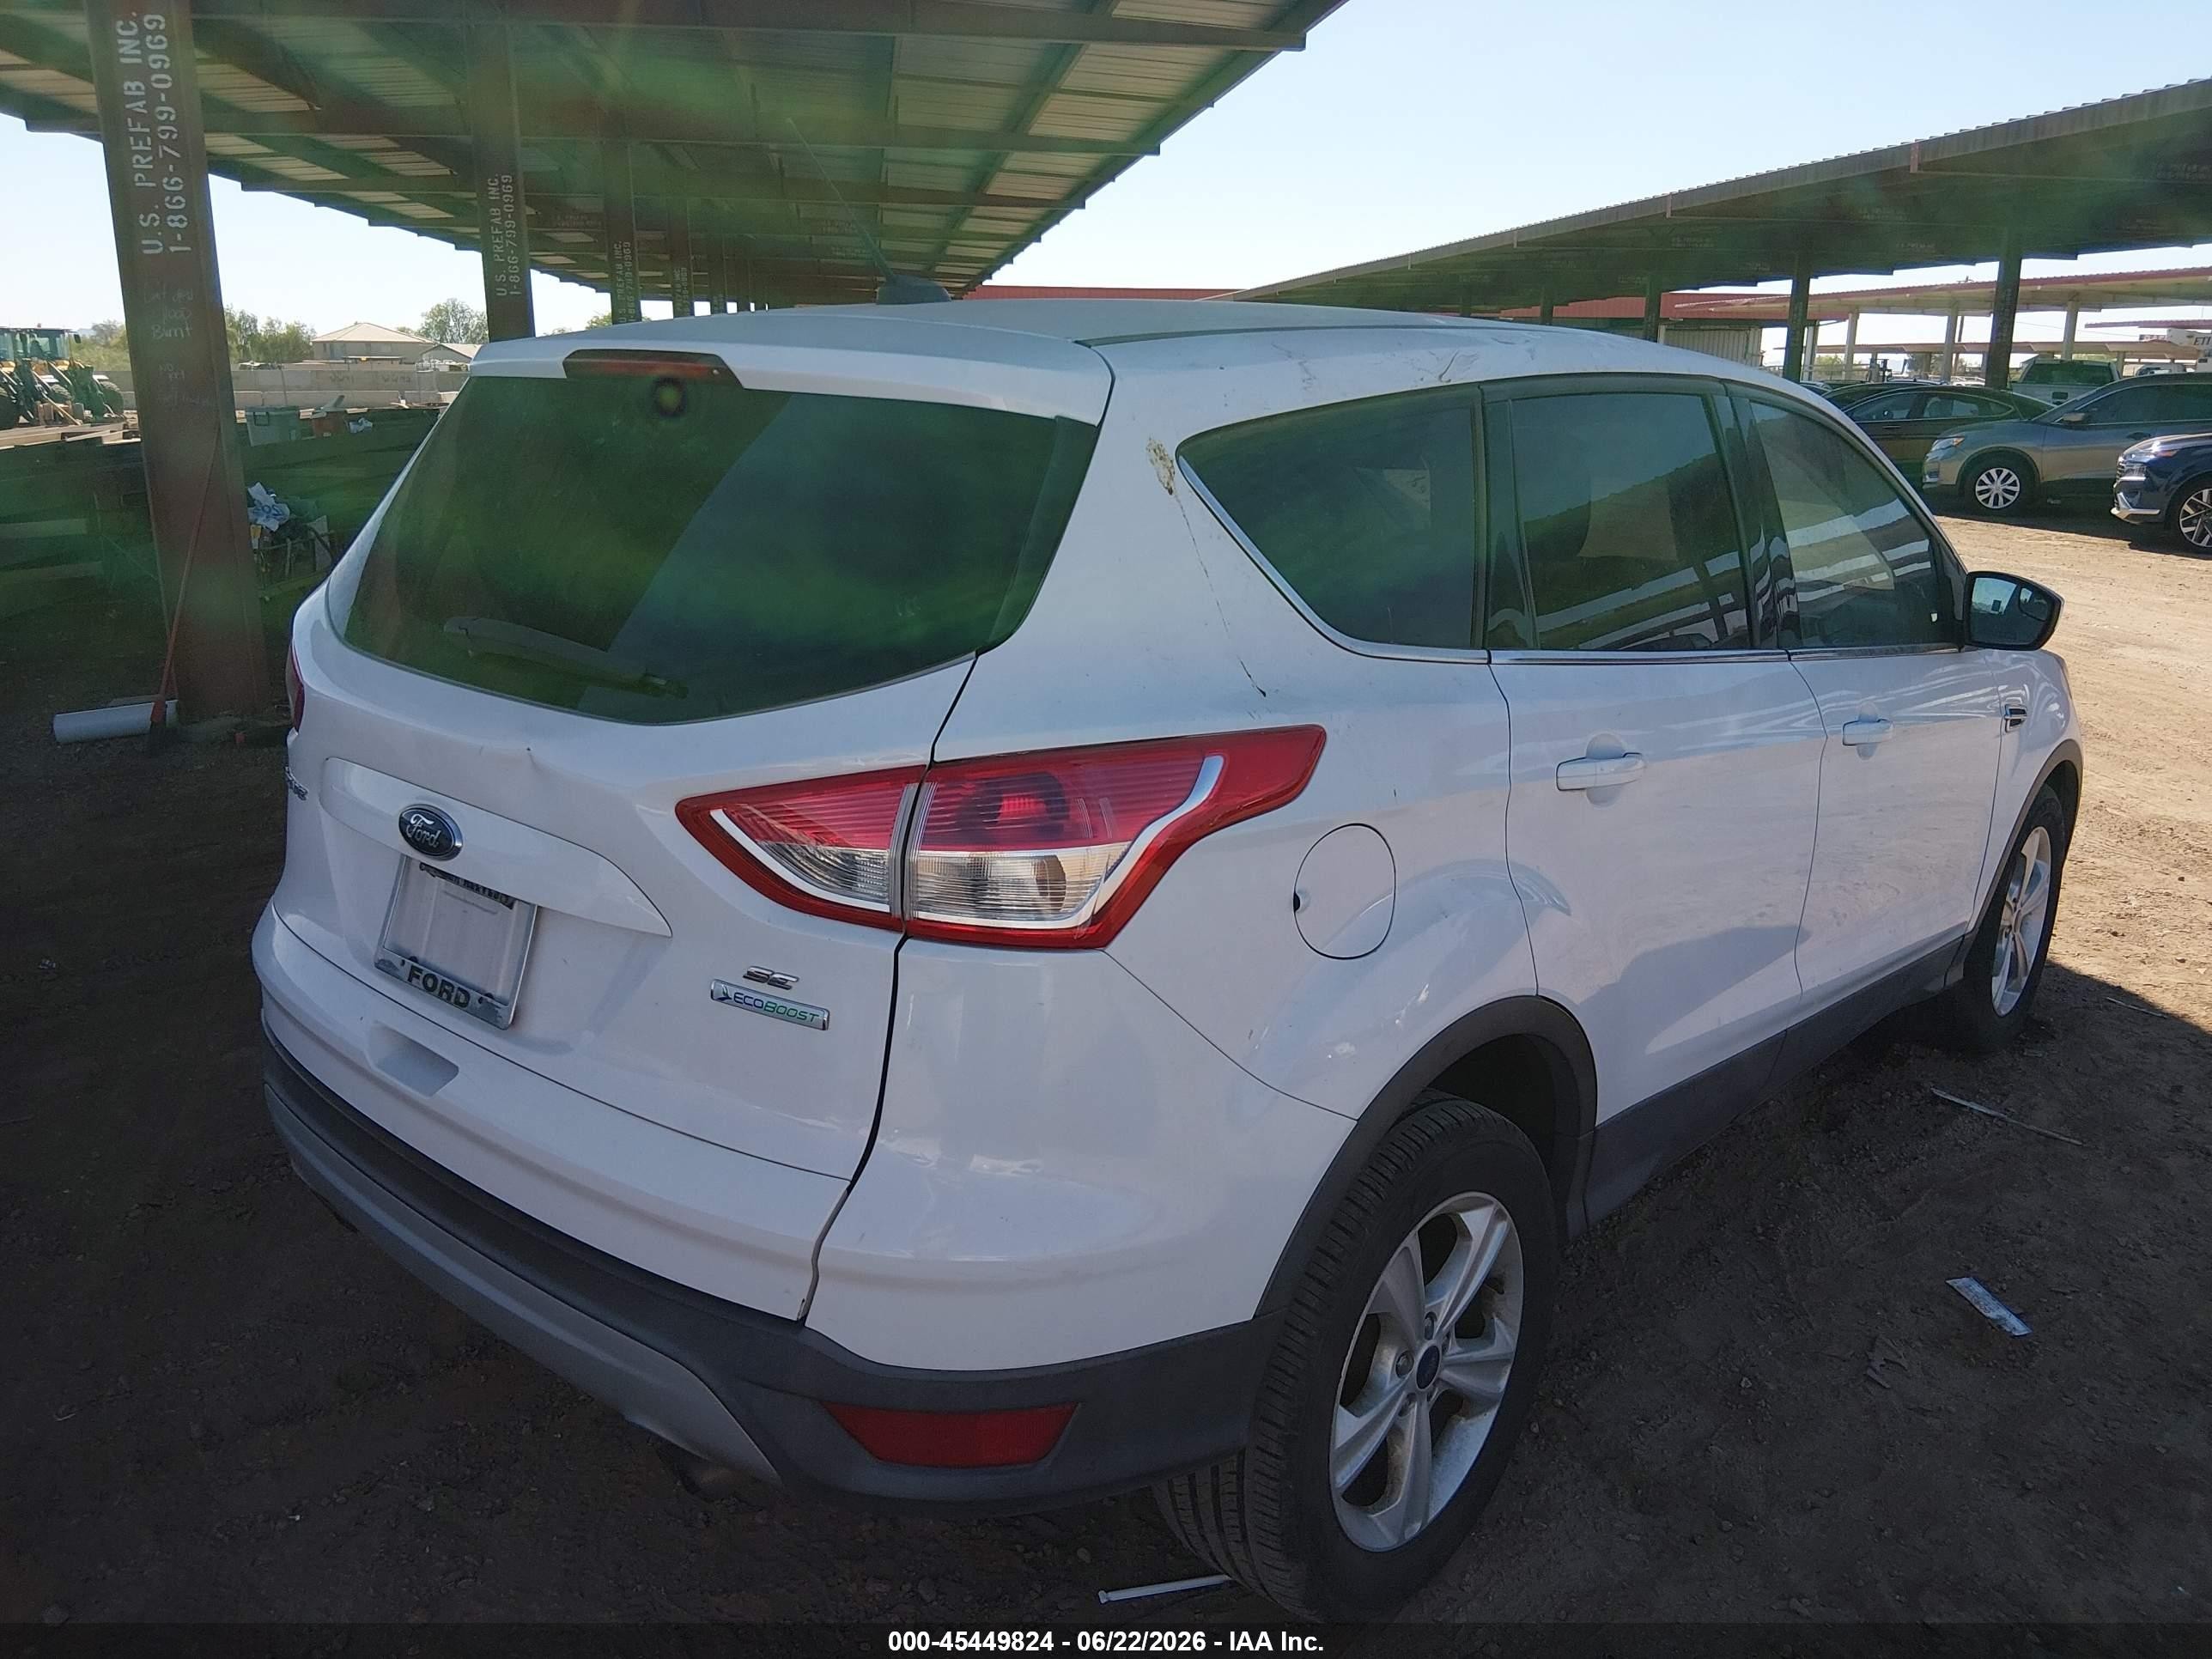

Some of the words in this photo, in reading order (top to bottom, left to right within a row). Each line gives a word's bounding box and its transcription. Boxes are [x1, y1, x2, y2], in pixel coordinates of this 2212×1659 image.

[116, 11, 143, 64] INC.
[125, 80, 157, 187] PREFAB
[143, 14, 192, 253] 1-866-799-0969
[487, 173, 500, 199] INC.
[139, 204, 164, 255] U.S.
[489, 206, 506, 263] PREFAB
[501, 174, 522, 296] 1-866-799-0969
[406, 813, 441, 848] Ford
[406, 964, 471, 1009] FORD
[742, 966, 800, 990] SE
[732, 992, 819, 1023] ECOBOOST
